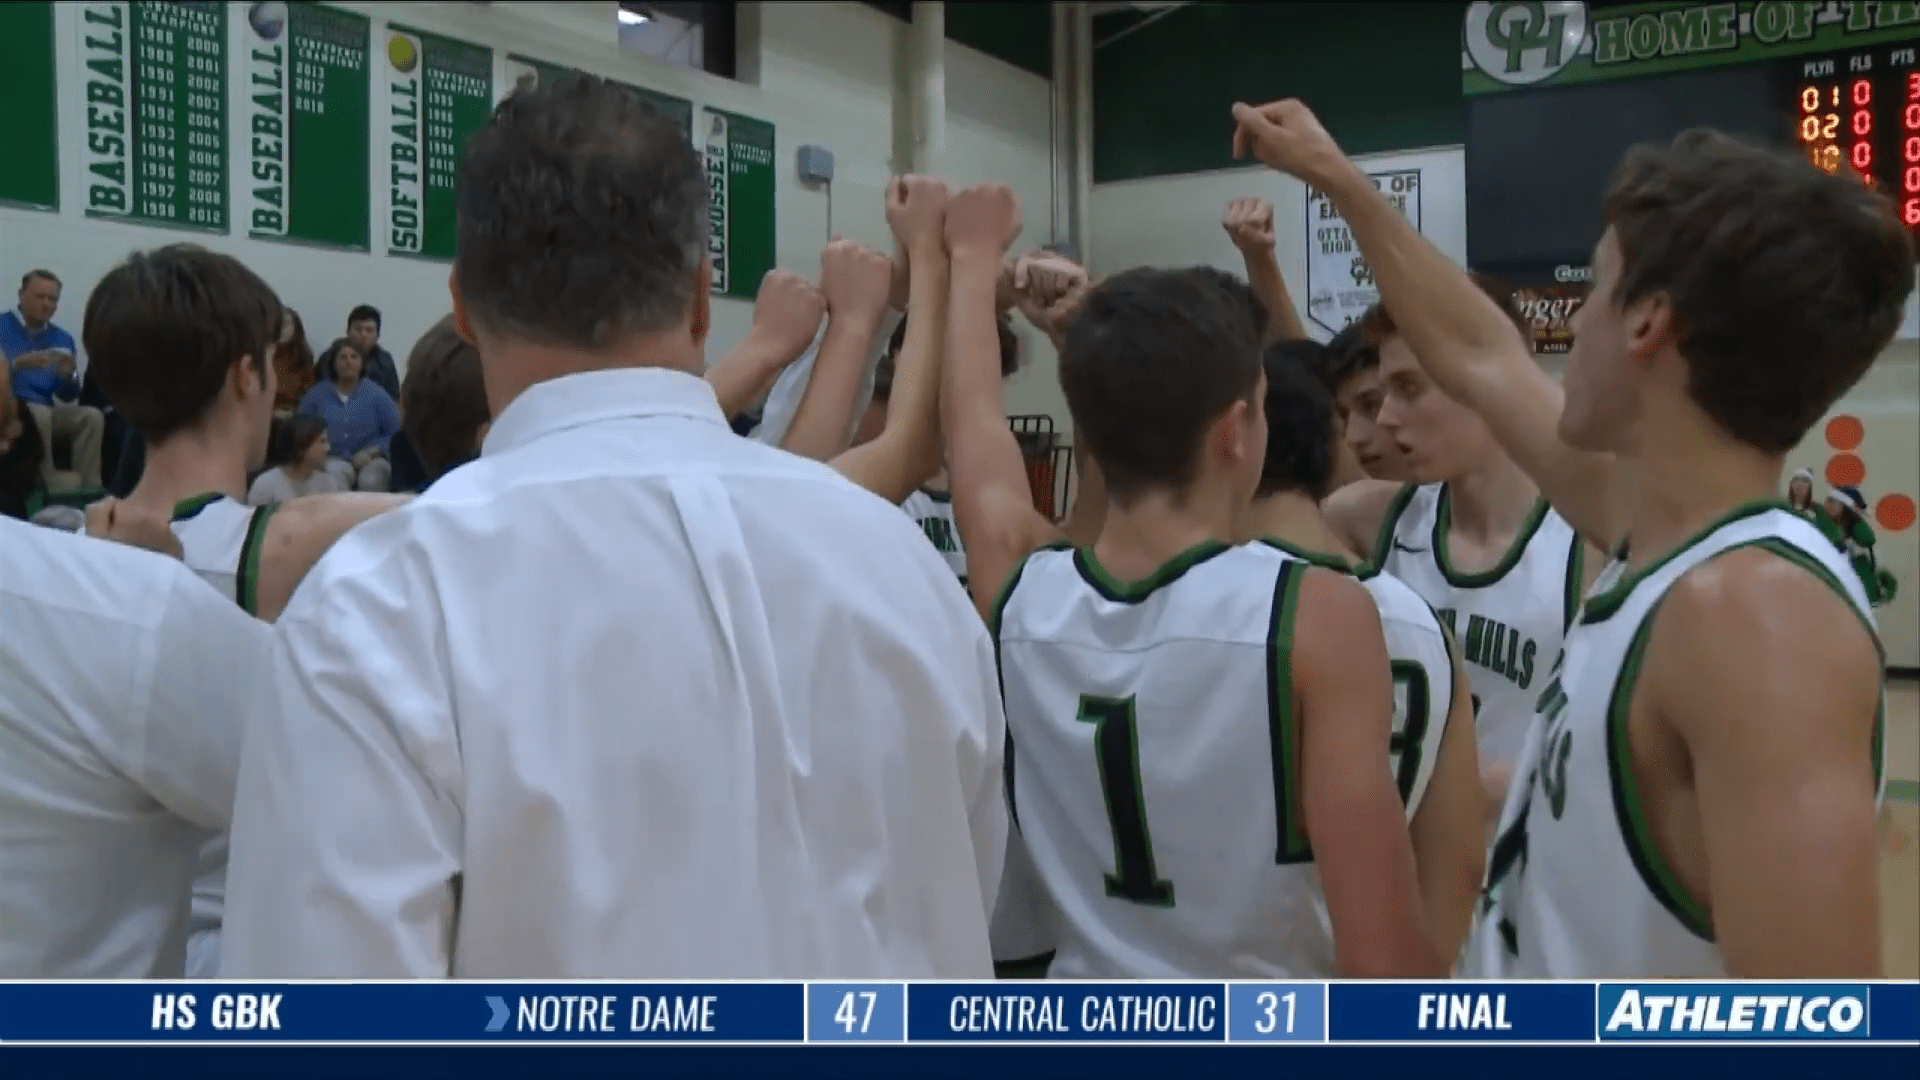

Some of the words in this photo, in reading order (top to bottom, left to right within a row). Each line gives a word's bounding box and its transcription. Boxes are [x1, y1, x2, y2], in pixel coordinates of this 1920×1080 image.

[142, 11, 216, 37] CHAMPIONS
[1594, 4, 1736, 63] HOME
[1753, 1, 1818, 42] OF
[187, 35, 220, 55] 2000
[140, 63, 174, 84] 1990
[187, 54, 220, 74] 2001
[1803, 60, 1835, 78] PLYR
[1850, 54, 1872, 72] FLS
[1890, 48, 1915, 66] PTS
[140, 83, 175, 103] 1991
[295, 77, 324, 95] 2017
[1802, 85, 1840, 113] 01
[1853, 79, 1871, 106] 0
[84, 4, 126, 211] BASEBALL
[187, 92, 220, 111] 2003
[188, 112, 220, 130] 2004
[1802, 113, 1840, 142] 02
[1853, 109, 1871, 136] 0
[1905, 103, 1920, 129] 0
[251, 43, 284, 231] BASEBALL
[1905, 136, 1920, 162] 0
[142, 142, 175, 160] 1994
[391, 79, 418, 249] SOFTBALL
[1853, 141, 1871, 168] 0
[142, 181, 175, 199] 1997
[188, 169, 220, 186] 2007
[1390, 175, 1417, 194] OF
[1905, 166, 1920, 193] 0
[707, 157, 725, 289] LACROSSE
[1905, 198, 1920, 224] 6
[1317, 227, 1350, 241] OTTA
[1465, 613, 1537, 690] HILLS
[1076, 692, 1176, 909] 1
